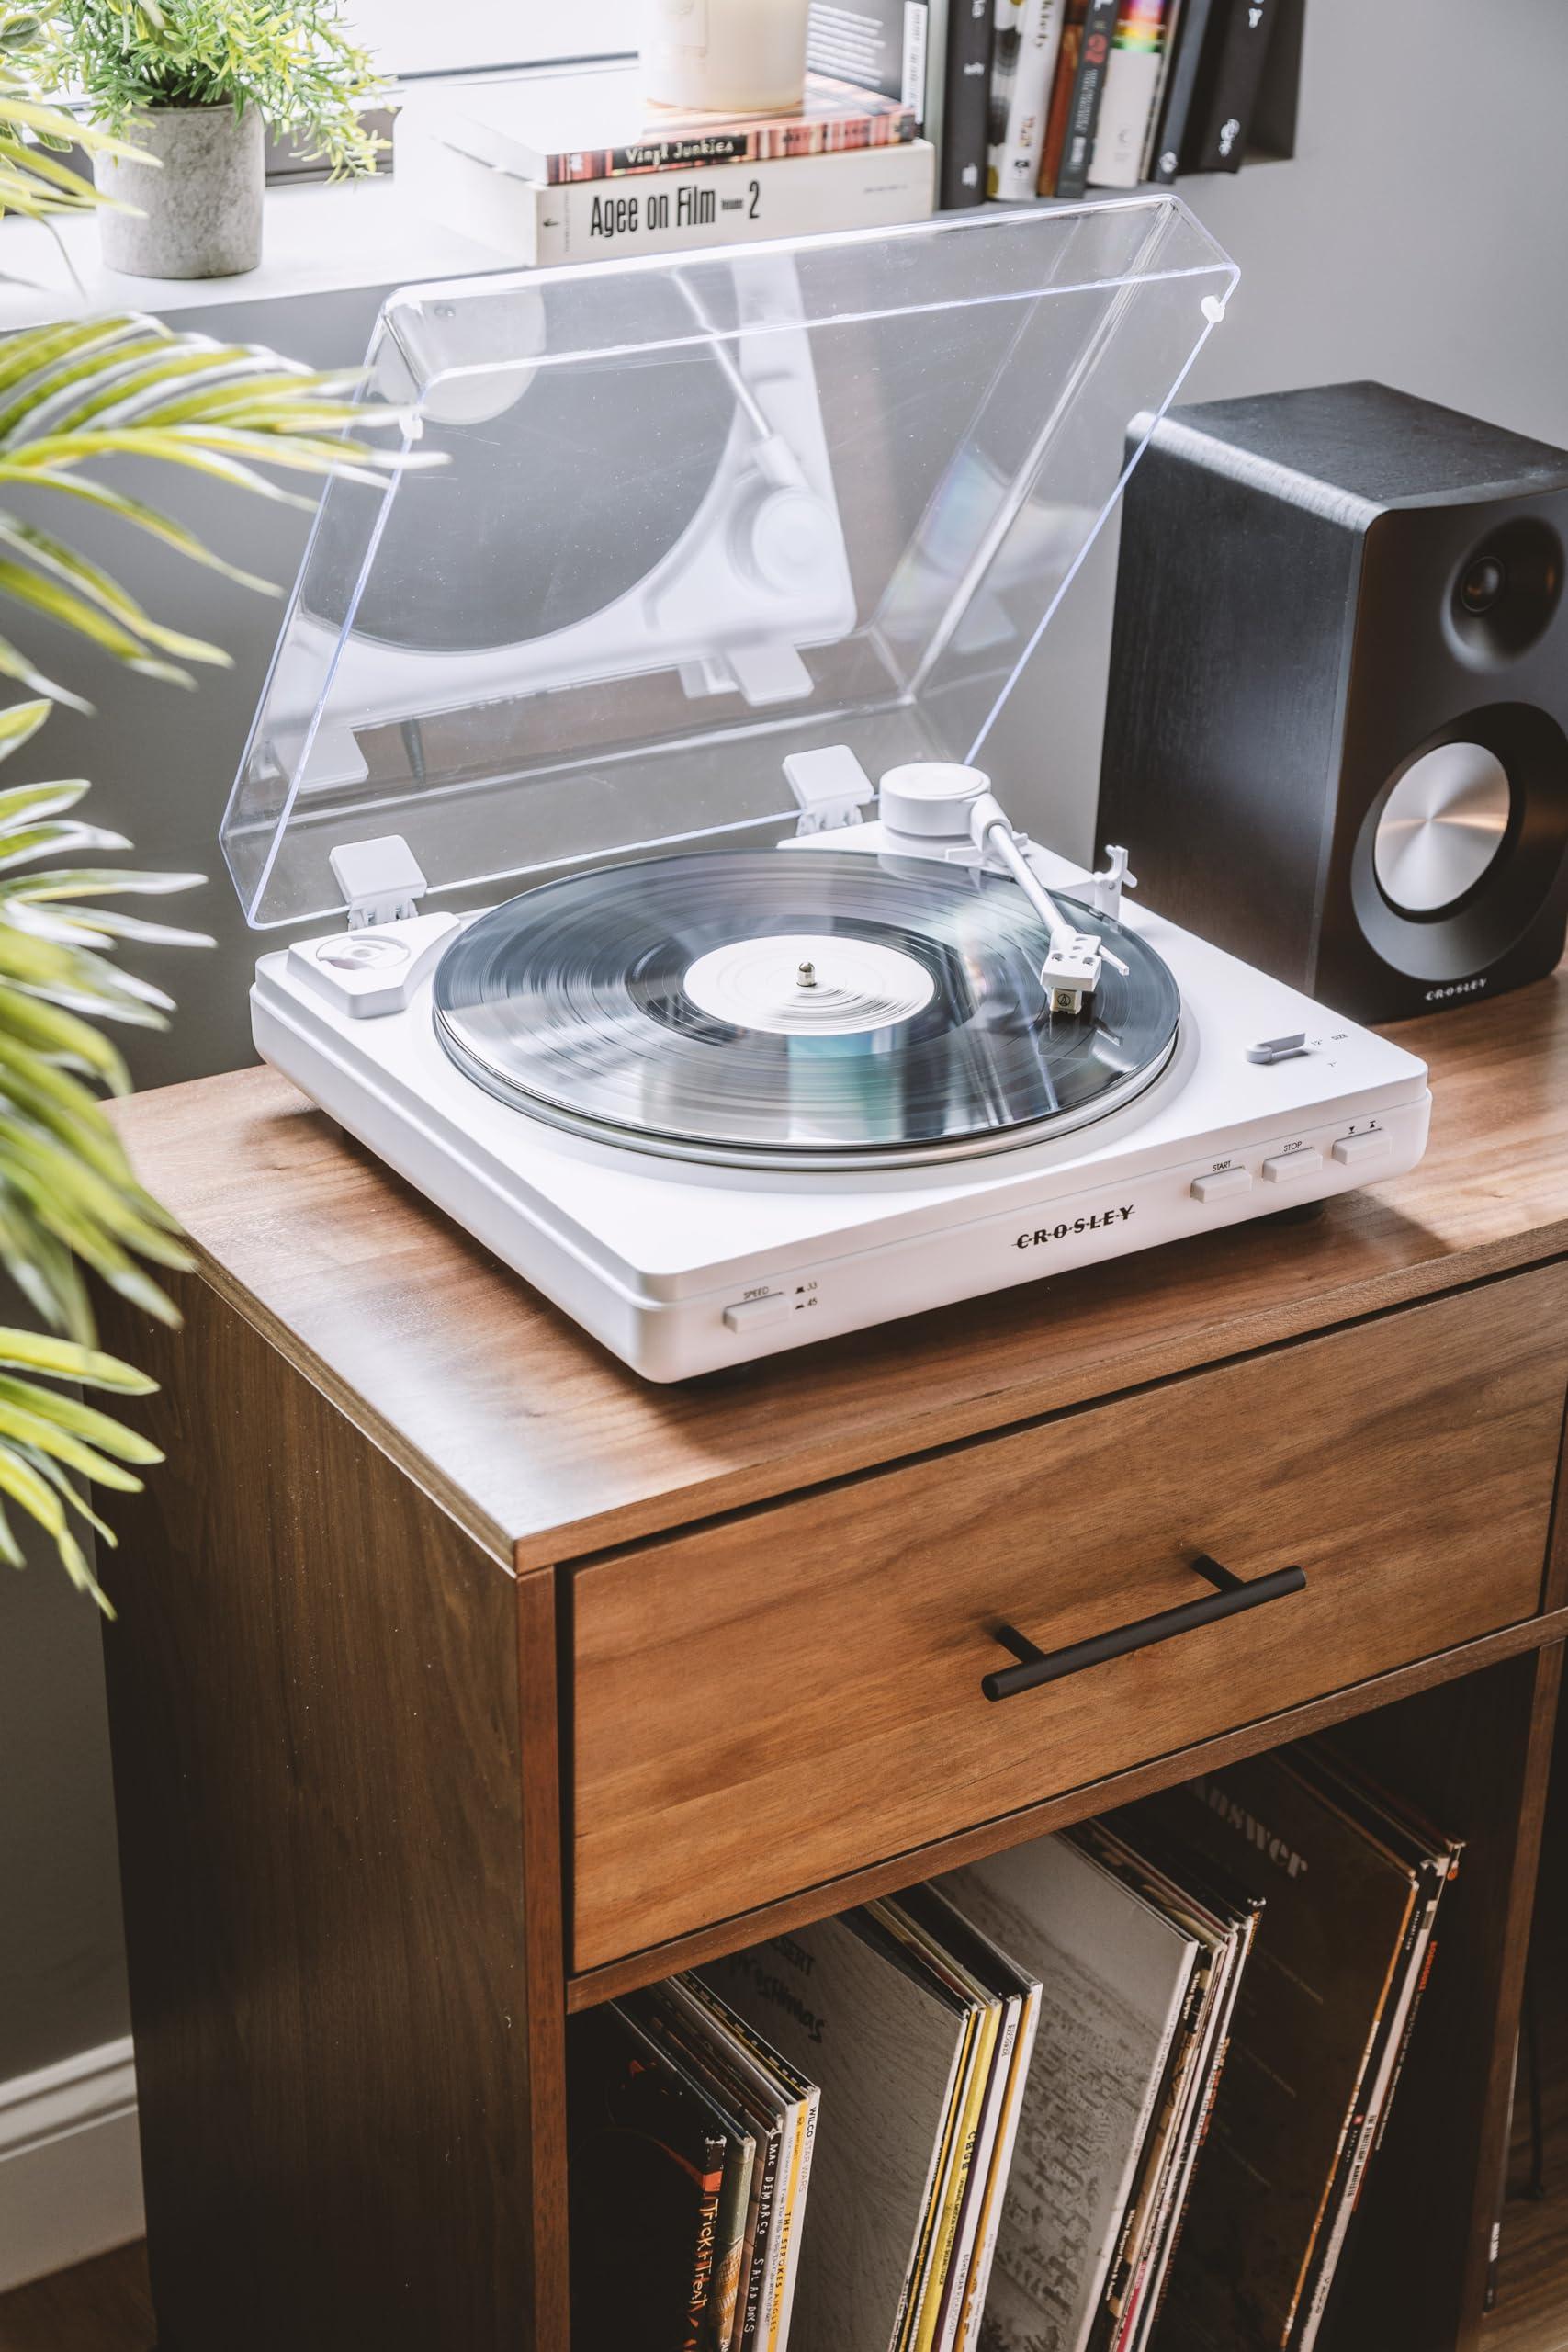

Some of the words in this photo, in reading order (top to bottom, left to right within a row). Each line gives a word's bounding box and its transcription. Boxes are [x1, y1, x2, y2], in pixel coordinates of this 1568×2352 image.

[626, 142, 668, 167] Vinyl
[673, 138, 734, 160] Junkies
[590, 195, 637, 238] Agee
[647, 194, 669, 230] on
[677, 184, 716, 226] Film
[749, 181, 760, 219] 2
[1426, 978, 1487, 1001] CROSLEY
[1283, 1141, 1303, 1152] STOP
[1213, 1160, 1231, 1171] START
[1014, 1204, 1135, 1249] CROSLEY
[743, 1286, 770, 1300] SPEED
[806, 2107, 817, 2138] WILCO
[783, 2212, 791, 2232] THE
[776, 2238, 789, 2288] STROKES
[769, 2293, 783, 2333] ANGLES
